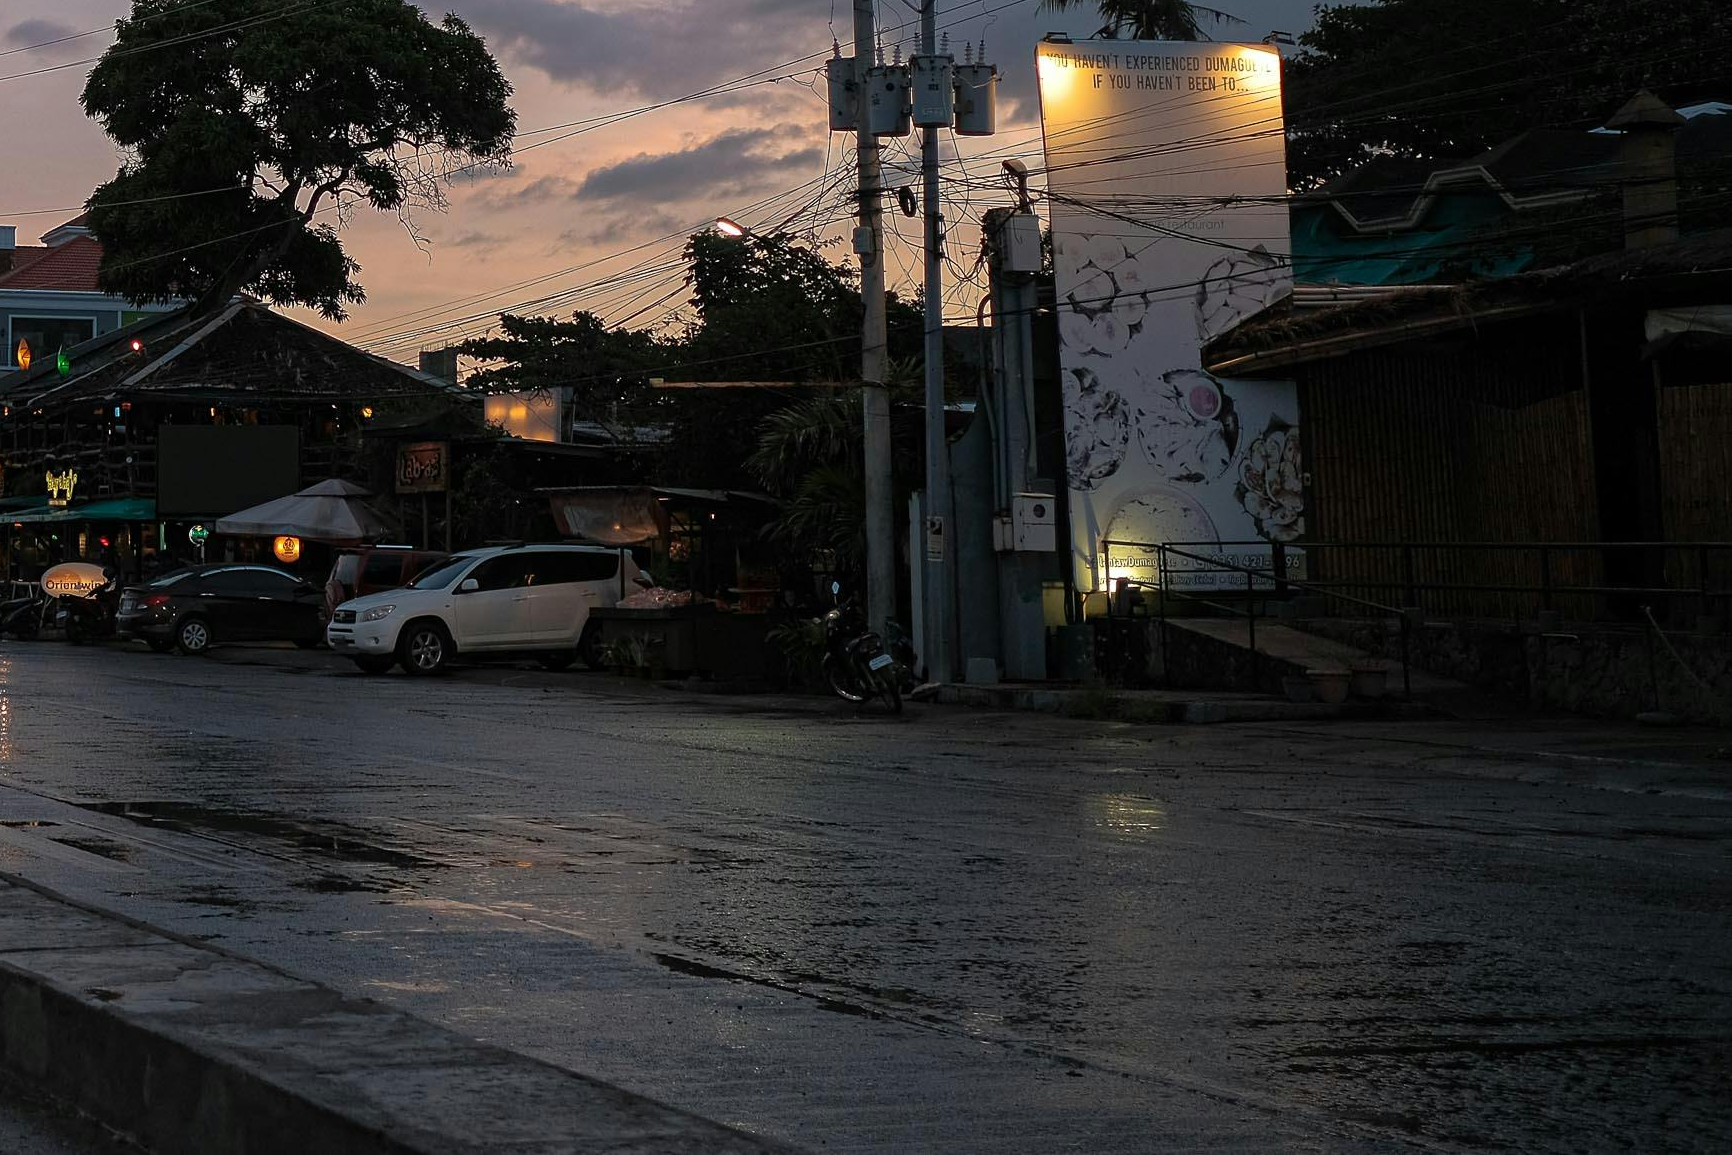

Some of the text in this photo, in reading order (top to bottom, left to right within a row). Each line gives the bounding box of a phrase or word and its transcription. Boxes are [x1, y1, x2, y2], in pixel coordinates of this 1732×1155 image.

[1074, 53, 1120, 69] HAVEN'T
[1126, 55, 1200, 71] EXPERIENCED
[1093, 74, 1249, 92] IF YOU HAVEN'T BEEN TO...
